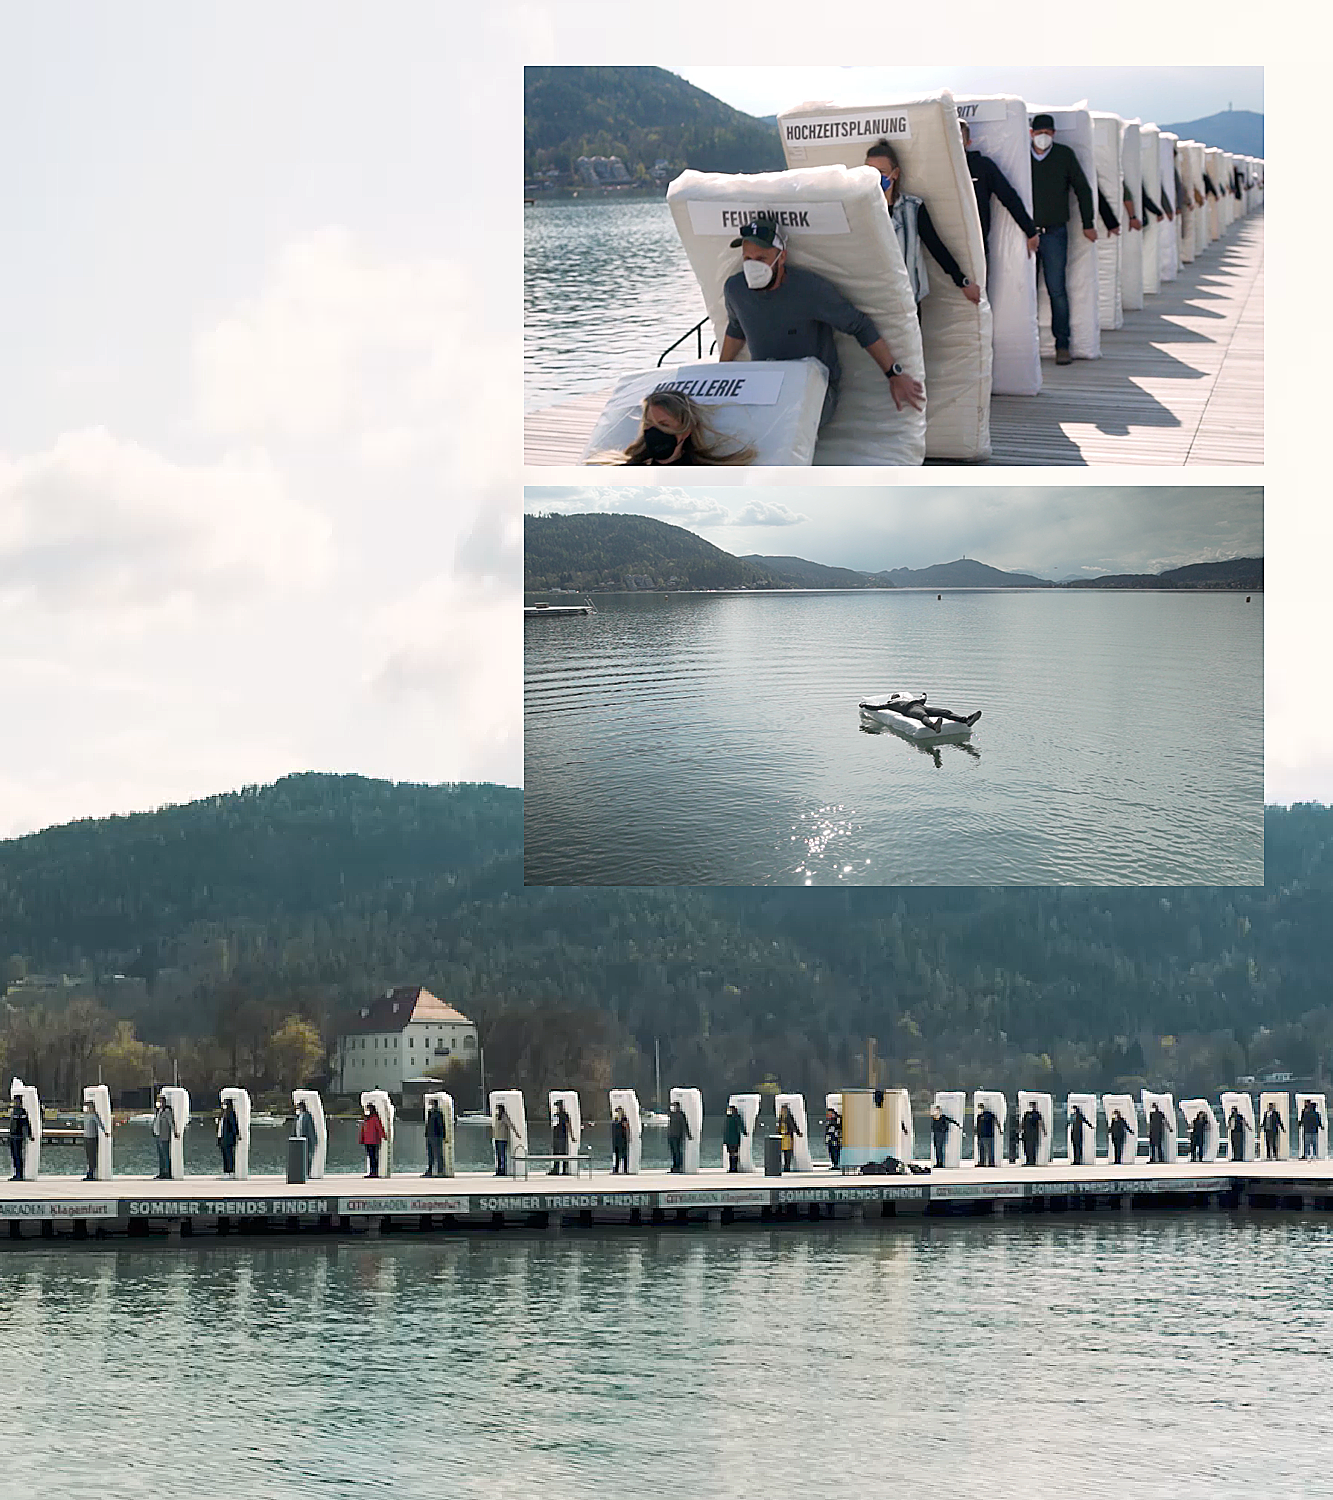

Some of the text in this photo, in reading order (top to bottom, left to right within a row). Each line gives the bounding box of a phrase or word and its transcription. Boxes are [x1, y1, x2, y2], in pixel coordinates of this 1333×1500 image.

[956, 104, 979, 118] RITY
[786, 116, 907, 140] HOCHZEITSPLANUNG
[129, 1199, 328, 1215] SOMMER TRENDS FINDEN
[480, 1197, 540, 1210] SOMMER
[545, 1195, 598, 1208] TRENDS
